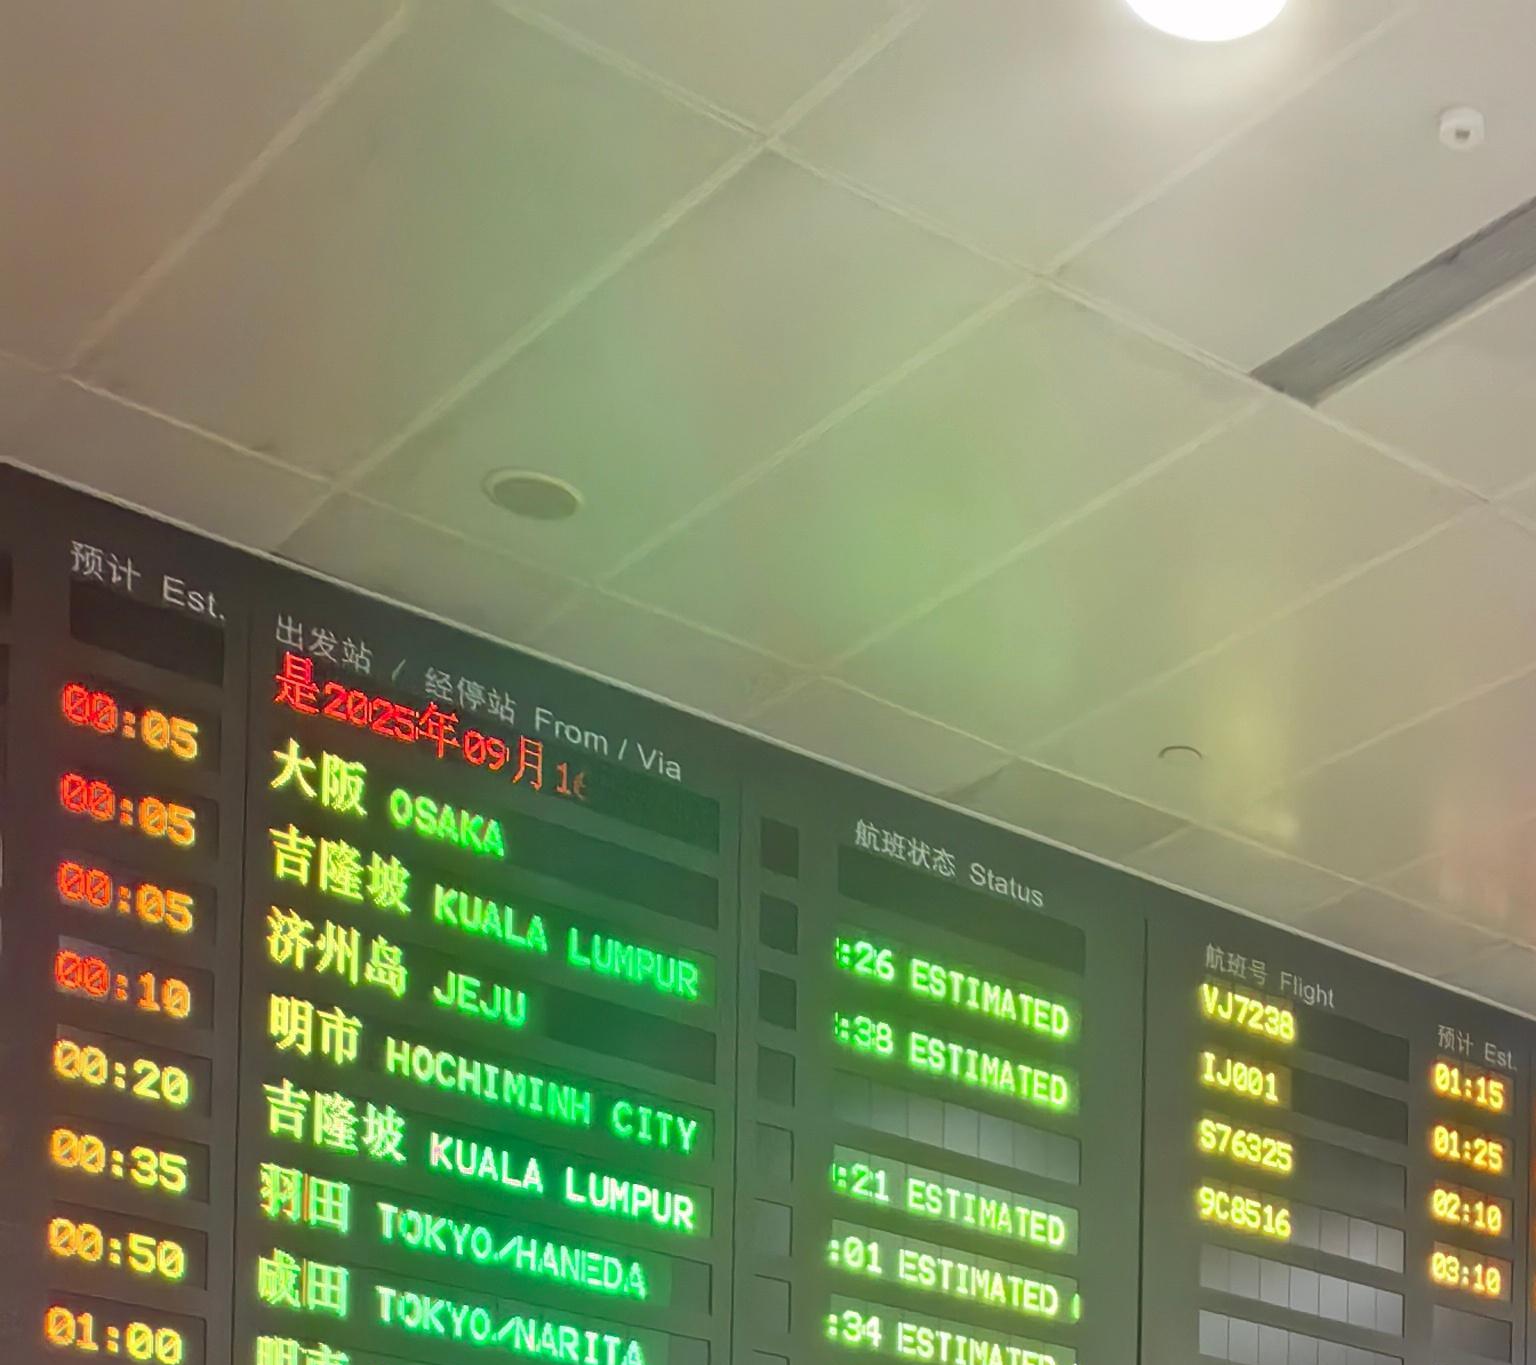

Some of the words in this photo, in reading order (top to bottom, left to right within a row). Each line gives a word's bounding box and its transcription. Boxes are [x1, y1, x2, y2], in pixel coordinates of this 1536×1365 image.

[70, 541, 141, 592] 预计
[163, 578, 226, 621] Est.
[62, 681, 198, 760] 00:05
[276, 616, 373, 677] 出发站
[425, 665, 516, 727] 经停站
[535, 708, 608, 757] From
[637, 744, 682, 782] Via
[60, 771, 195, 846] 00:05
[271, 738, 368, 818] 大阪
[389, 788, 504, 856] OSAKA
[58, 860, 194, 934] 00:05
[854, 818, 956, 877] 航班状态
[969, 862, 1044, 908] Status
[269, 823, 412, 914] 吉隆坡
[433, 884, 547, 952] KUALA
[569, 927, 699, 998] LUMPUR
[55, 949, 191, 1019] 00:10
[266, 906, 406, 996] 济州岛
[433, 971, 527, 1026] JEJU
[834, 936, 895, 981] :26
[910, 957, 1071, 1038] ESTIMATED
[1205, 943, 1267, 987] 航班号
[1280, 971, 1335, 1010] Flight
[1200, 983, 1296, 1042] VJ7238
[53, 1039, 189, 1105] 00:20
[269, 992, 364, 1066] 明市
[386, 1035, 591, 1127] HOCHIMINH
[612, 1104, 697, 1153] CITY
[834, 1011, 894, 1056] :38
[909, 1032, 1069, 1110] ESTIMATED
[1202, 1051, 1278, 1103] IJ001
[1436, 1025, 1474, 1054] 预计
[1485, 1042, 1518, 1072] Est.
[1434, 1063, 1504, 1110] 01:15
[51, 1128, 188, 1193] 00:35
[263, 1077, 407, 1164] 吉隆坡
[430, 1133, 544, 1193] KUALA
[566, 1173, 696, 1233] LUMPUR
[1200, 1118, 1293, 1174] S76325
[1433, 1124, 1503, 1172] 01:25
[259, 1161, 350, 1234] 羽田
[376, 1201, 649, 1299] TOKYO/HANEDA
[832, 1162, 889, 1203] :21
[907, 1178, 1066, 1250] ESTIMATED
[1199, 1186, 1291, 1239] 9C8516
[1432, 1188, 1502, 1235] 02:10
[48, 1217, 185, 1278] 00:50
[258, 1247, 348, 1317] 成田
[1431, 1251, 1501, 1295] 03:10
[899, 1249, 1059, 1321] ESTIMATED
[45, 1306, 183, 1365] 01:00
